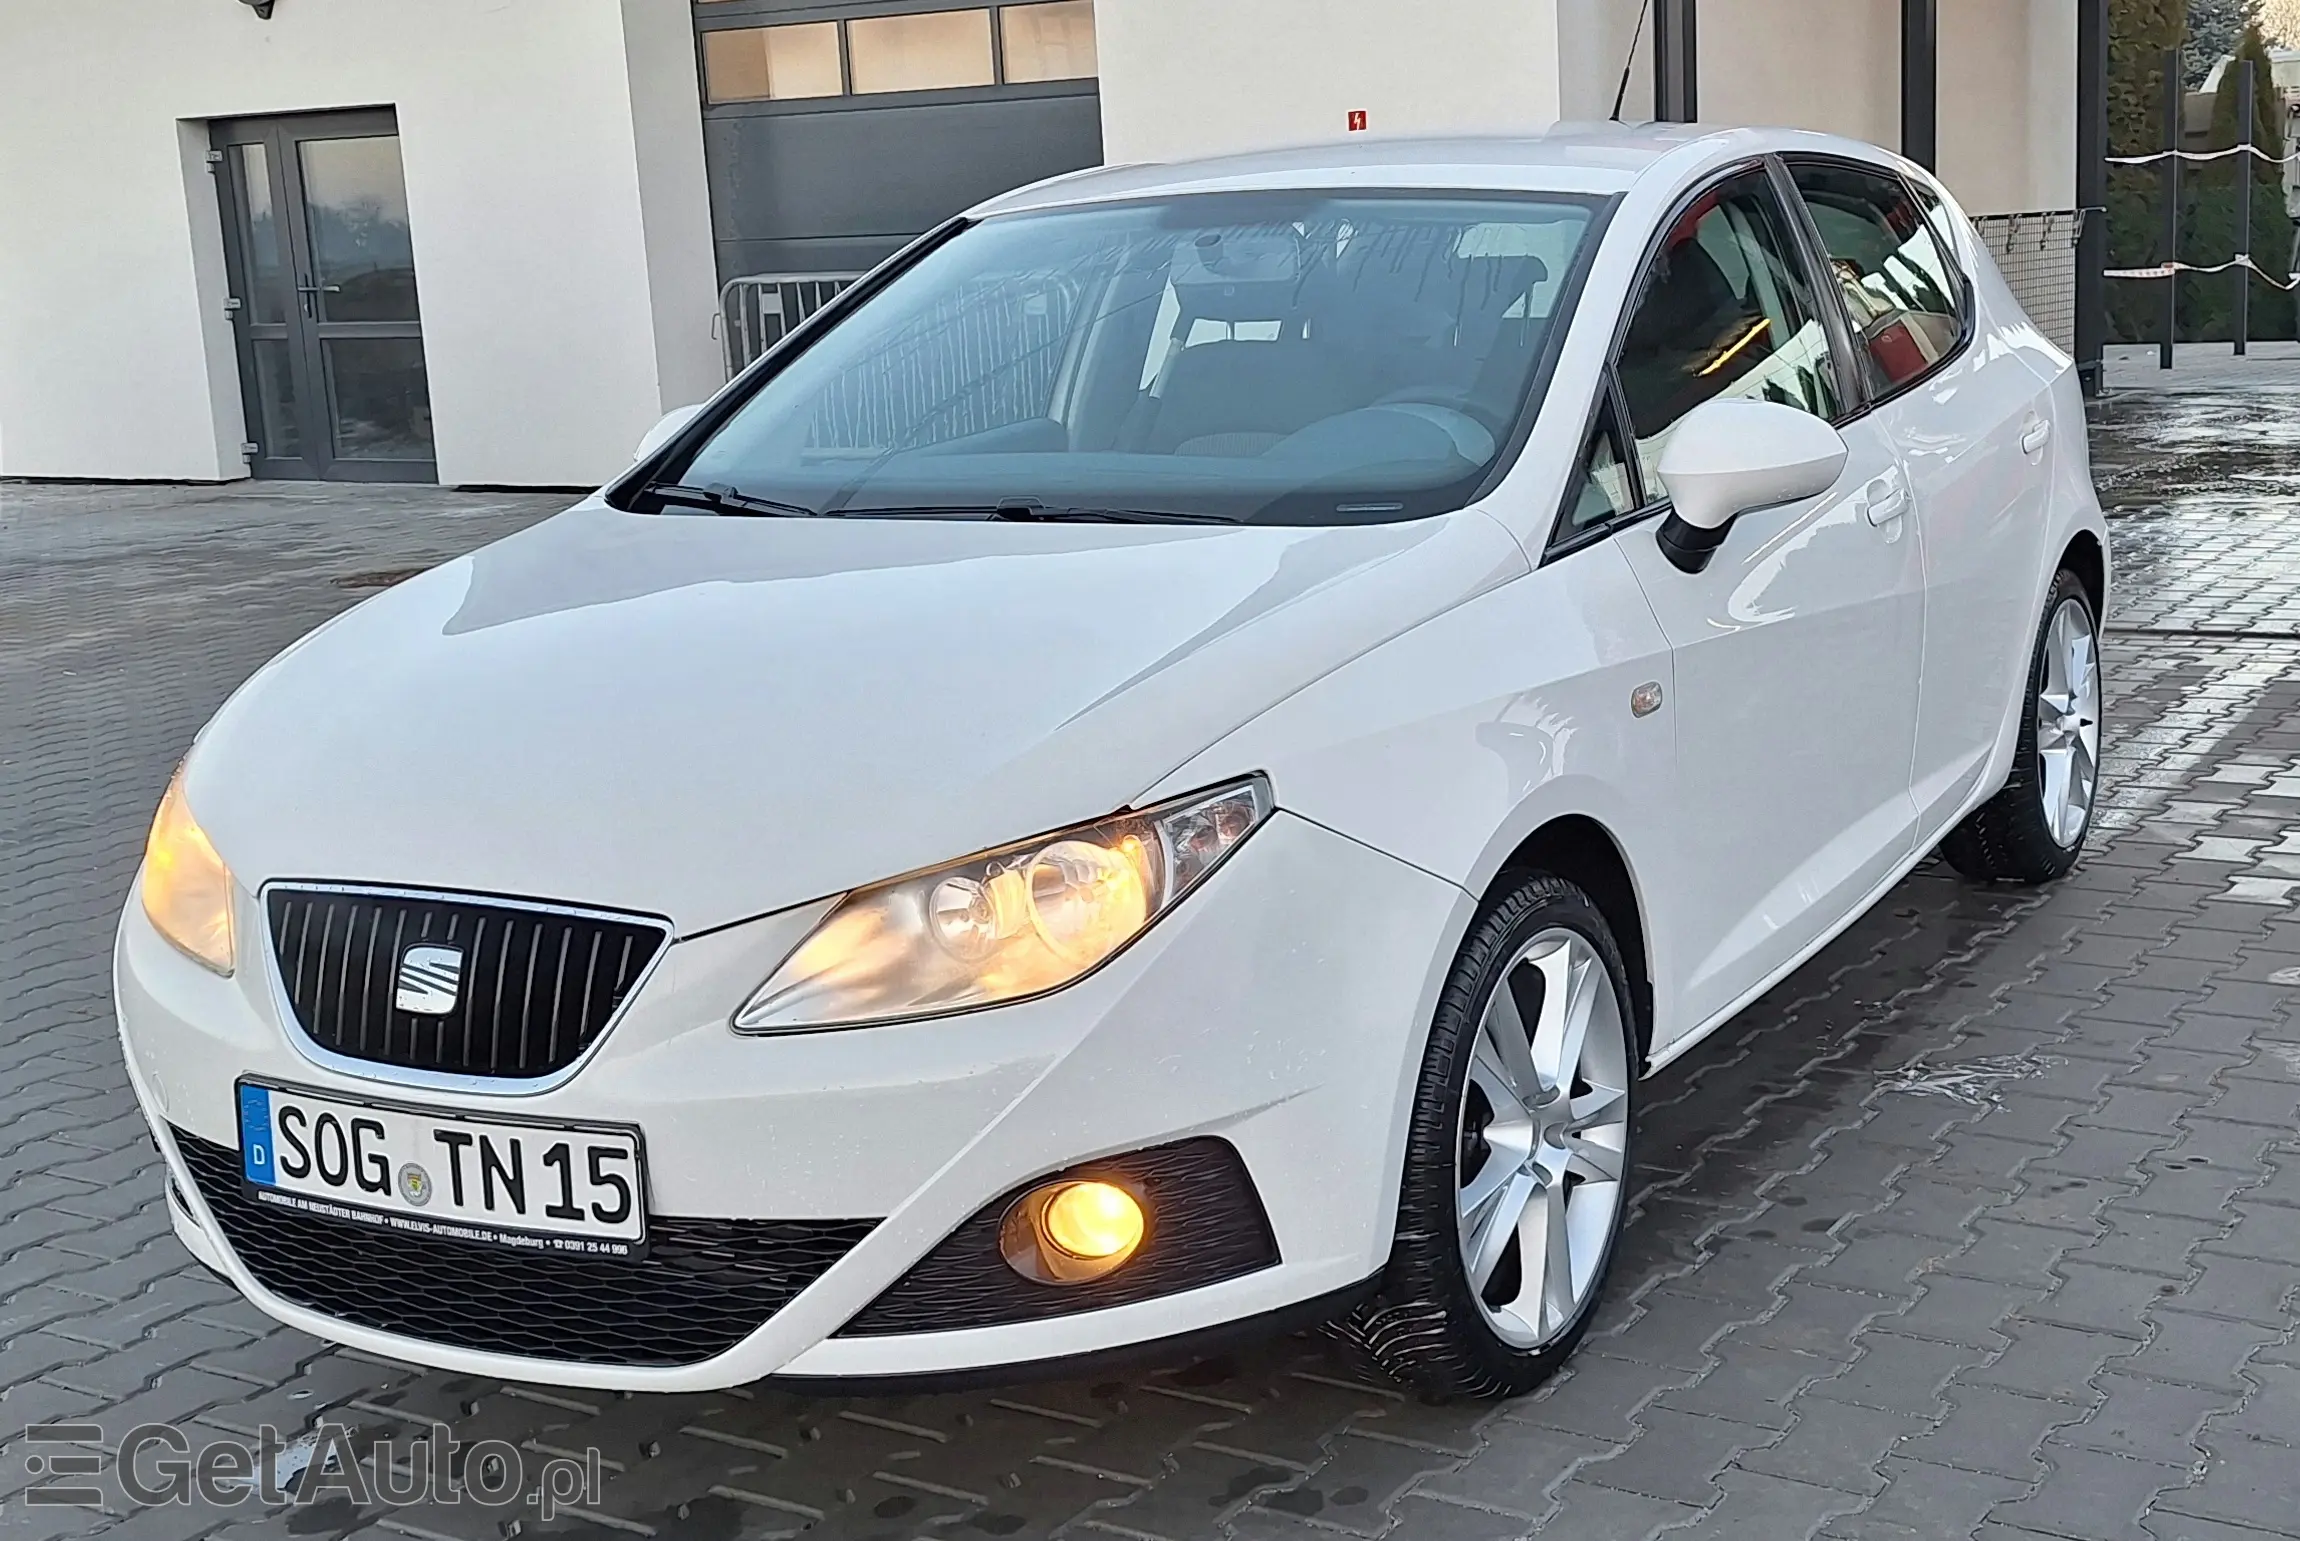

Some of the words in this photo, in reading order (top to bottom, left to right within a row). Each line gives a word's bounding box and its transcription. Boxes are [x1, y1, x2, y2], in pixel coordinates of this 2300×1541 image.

[253, 1144, 266, 1166] D
[278, 1105, 392, 1196] SOG
[433, 1129, 526, 1215] TN
[543, 1142, 632, 1225] 15
[258, 1191, 297, 1207] AUTOMOBILE
[297, 1199, 309, 1210] AM
[351, 1209, 384, 1225] BAHNHOF
[499, 1234, 545, 1249] Magdeburg
[587, 1241, 598, 1253] 25
[600, 1243, 611, 1254] 44
